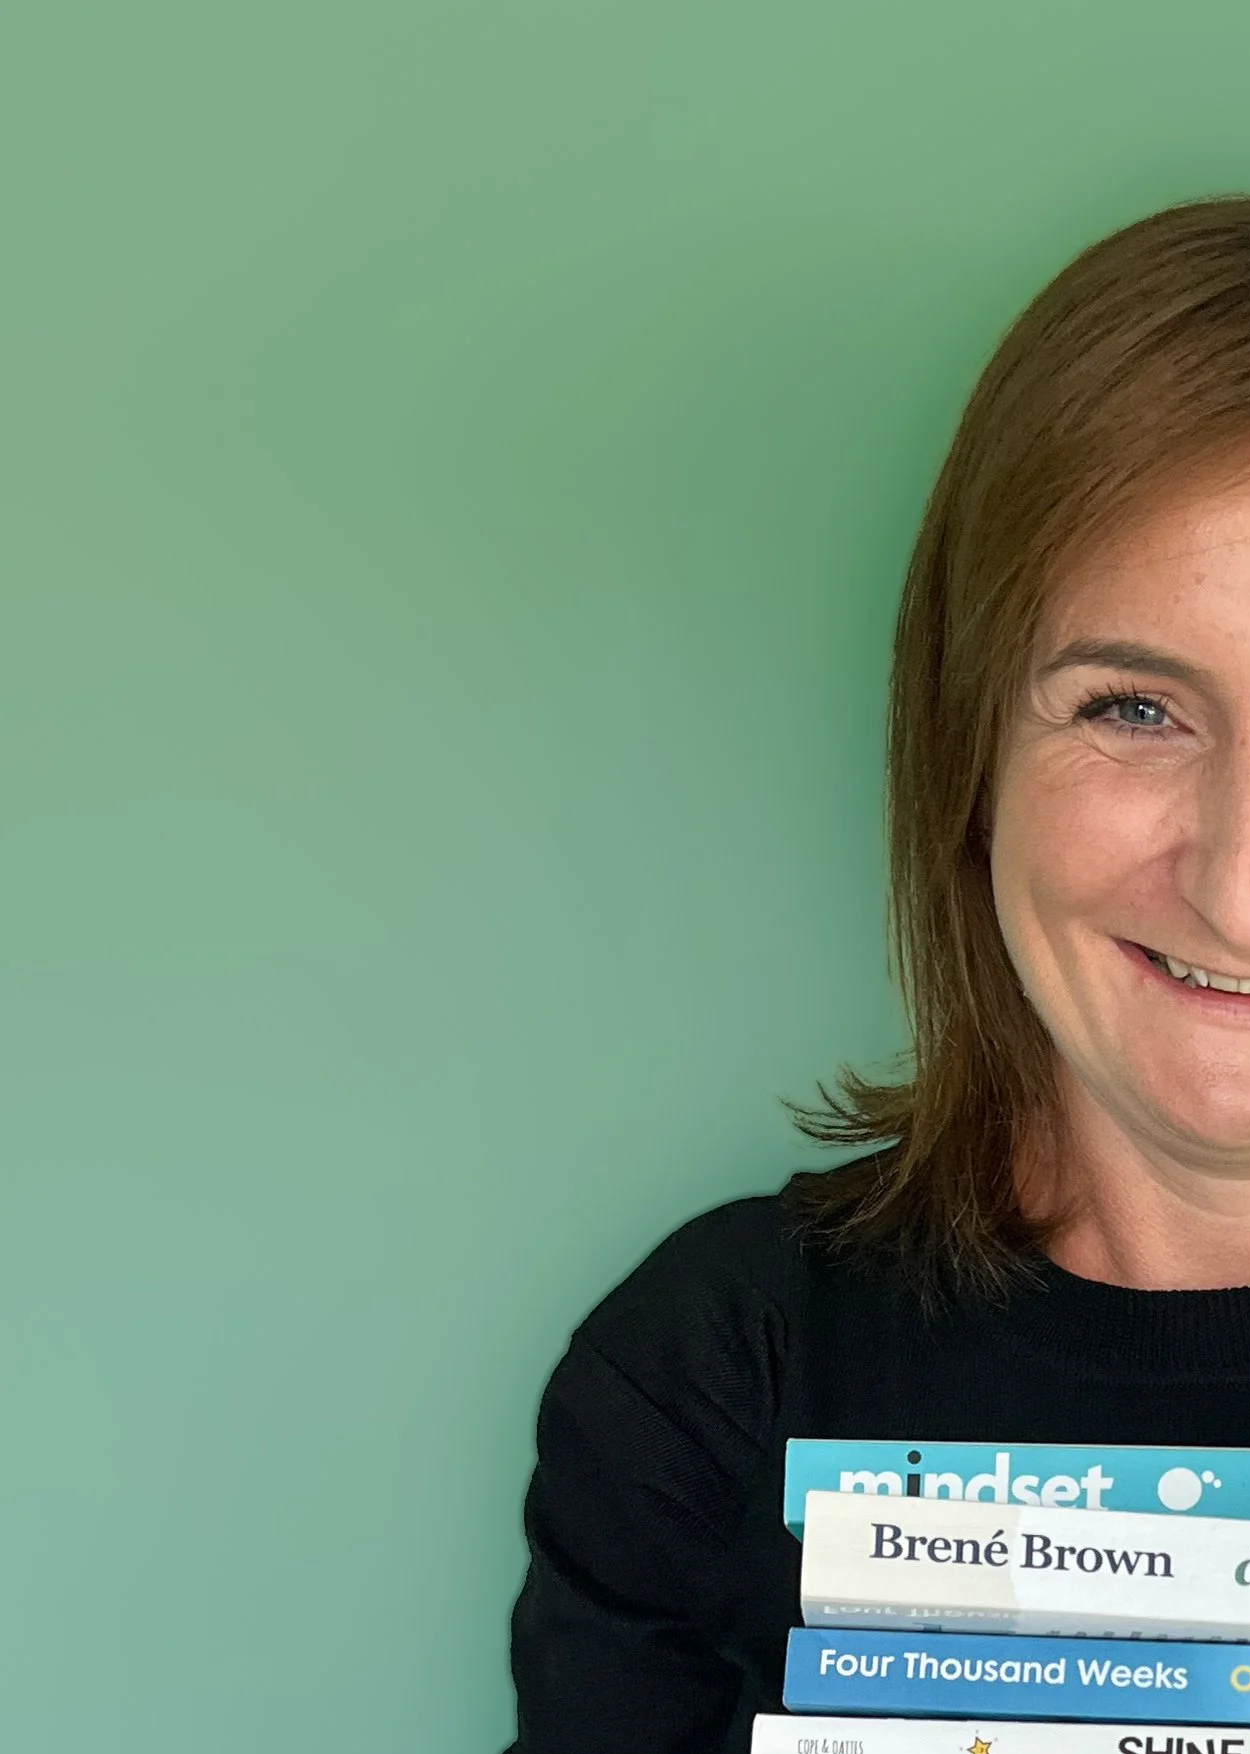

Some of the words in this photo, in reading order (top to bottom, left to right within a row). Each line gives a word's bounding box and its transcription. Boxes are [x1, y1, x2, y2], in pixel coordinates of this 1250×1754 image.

[840, 1450, 1114, 1511] mindset
[870, 1523, 1009, 1566] Brené
[1020, 1533, 1174, 1578] Brown
[819, 1649, 895, 1678] Four
[904, 1652, 1065, 1685] Thousand
[1076, 1658, 1188, 1690] Weeks
[797, 1738, 818, 1754] COPE
[821, 1738, 830, 1754] &
